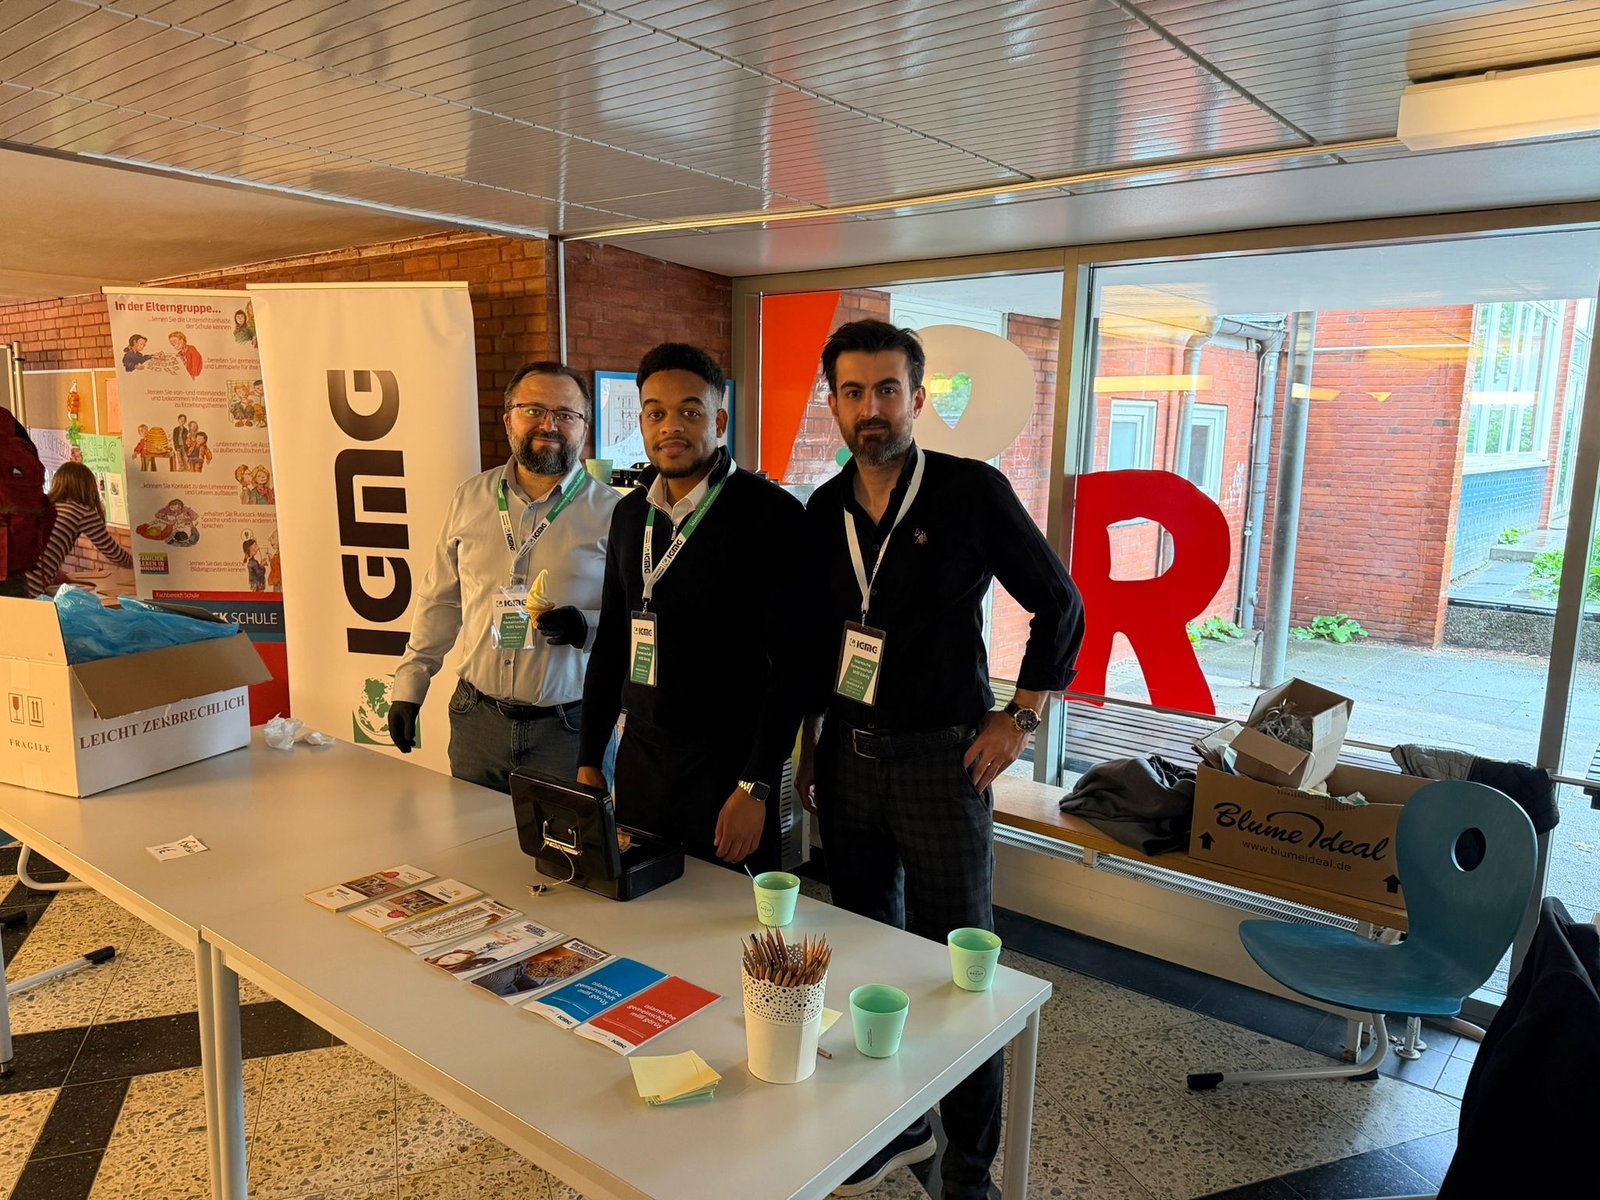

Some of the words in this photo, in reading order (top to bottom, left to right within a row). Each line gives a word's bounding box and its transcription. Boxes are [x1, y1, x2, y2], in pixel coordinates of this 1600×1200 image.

[115, 302, 125, 311] In
[128, 302, 143, 312] der
[326, 369, 412, 656] IGMG
[533, 522, 547, 540] IGMG
[506, 532, 516, 551] IGMG
[667, 538, 683, 560] IGMG
[231, 612, 277, 625] SCHULE
[856, 640, 878, 654] IGMG
[79, 723, 139, 749] LEICHT
[10, 738, 50, 753] FRAGILE
[1214, 802, 1303, 844] Blume
[1266, 810, 1389, 861] Ideal
[1242, 840, 1352, 872] www.blumeideal.de
[591, 981, 622, 998] islamische
[626, 1005, 670, 1025] gemeinschaft
[644, 1004, 677, 1021] islamische
